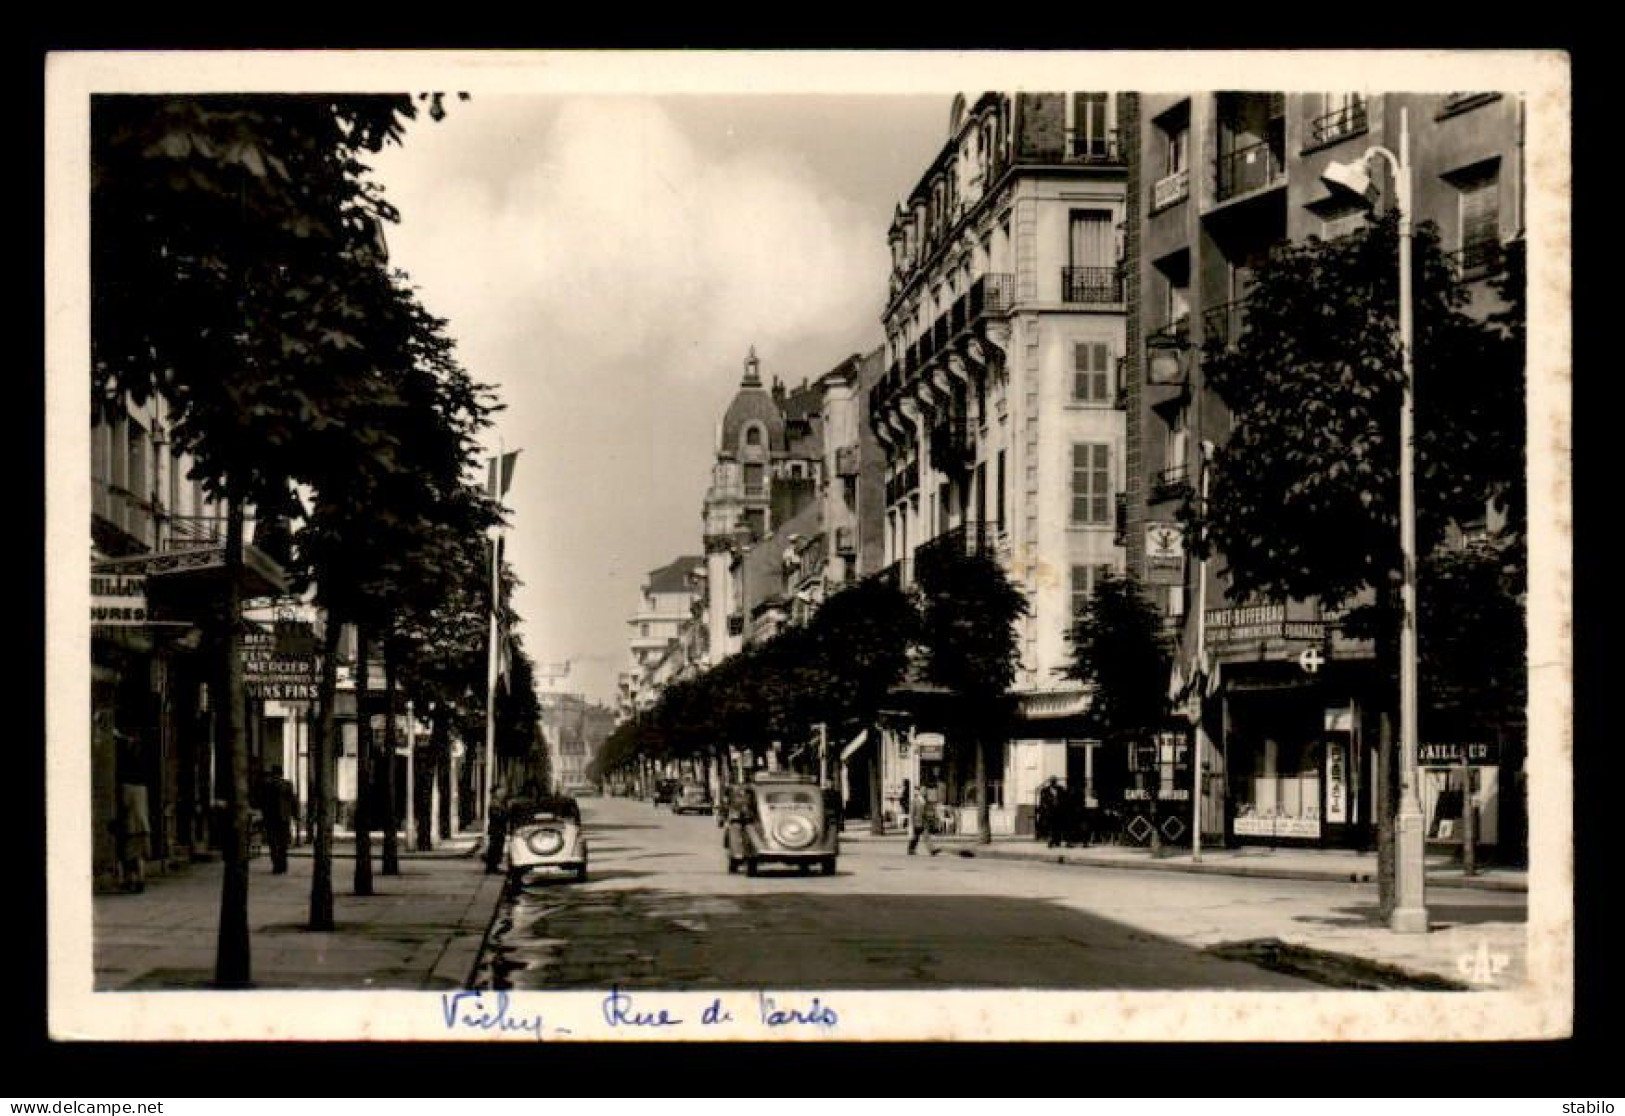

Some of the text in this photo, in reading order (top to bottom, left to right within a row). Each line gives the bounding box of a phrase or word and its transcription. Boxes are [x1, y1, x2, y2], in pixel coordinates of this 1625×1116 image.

[285, 684, 318, 698] FINS
[442, 990, 542, 1041] Vichy
[603, 984, 683, 1026] Rue
[760, 990, 838, 1027] Paris
